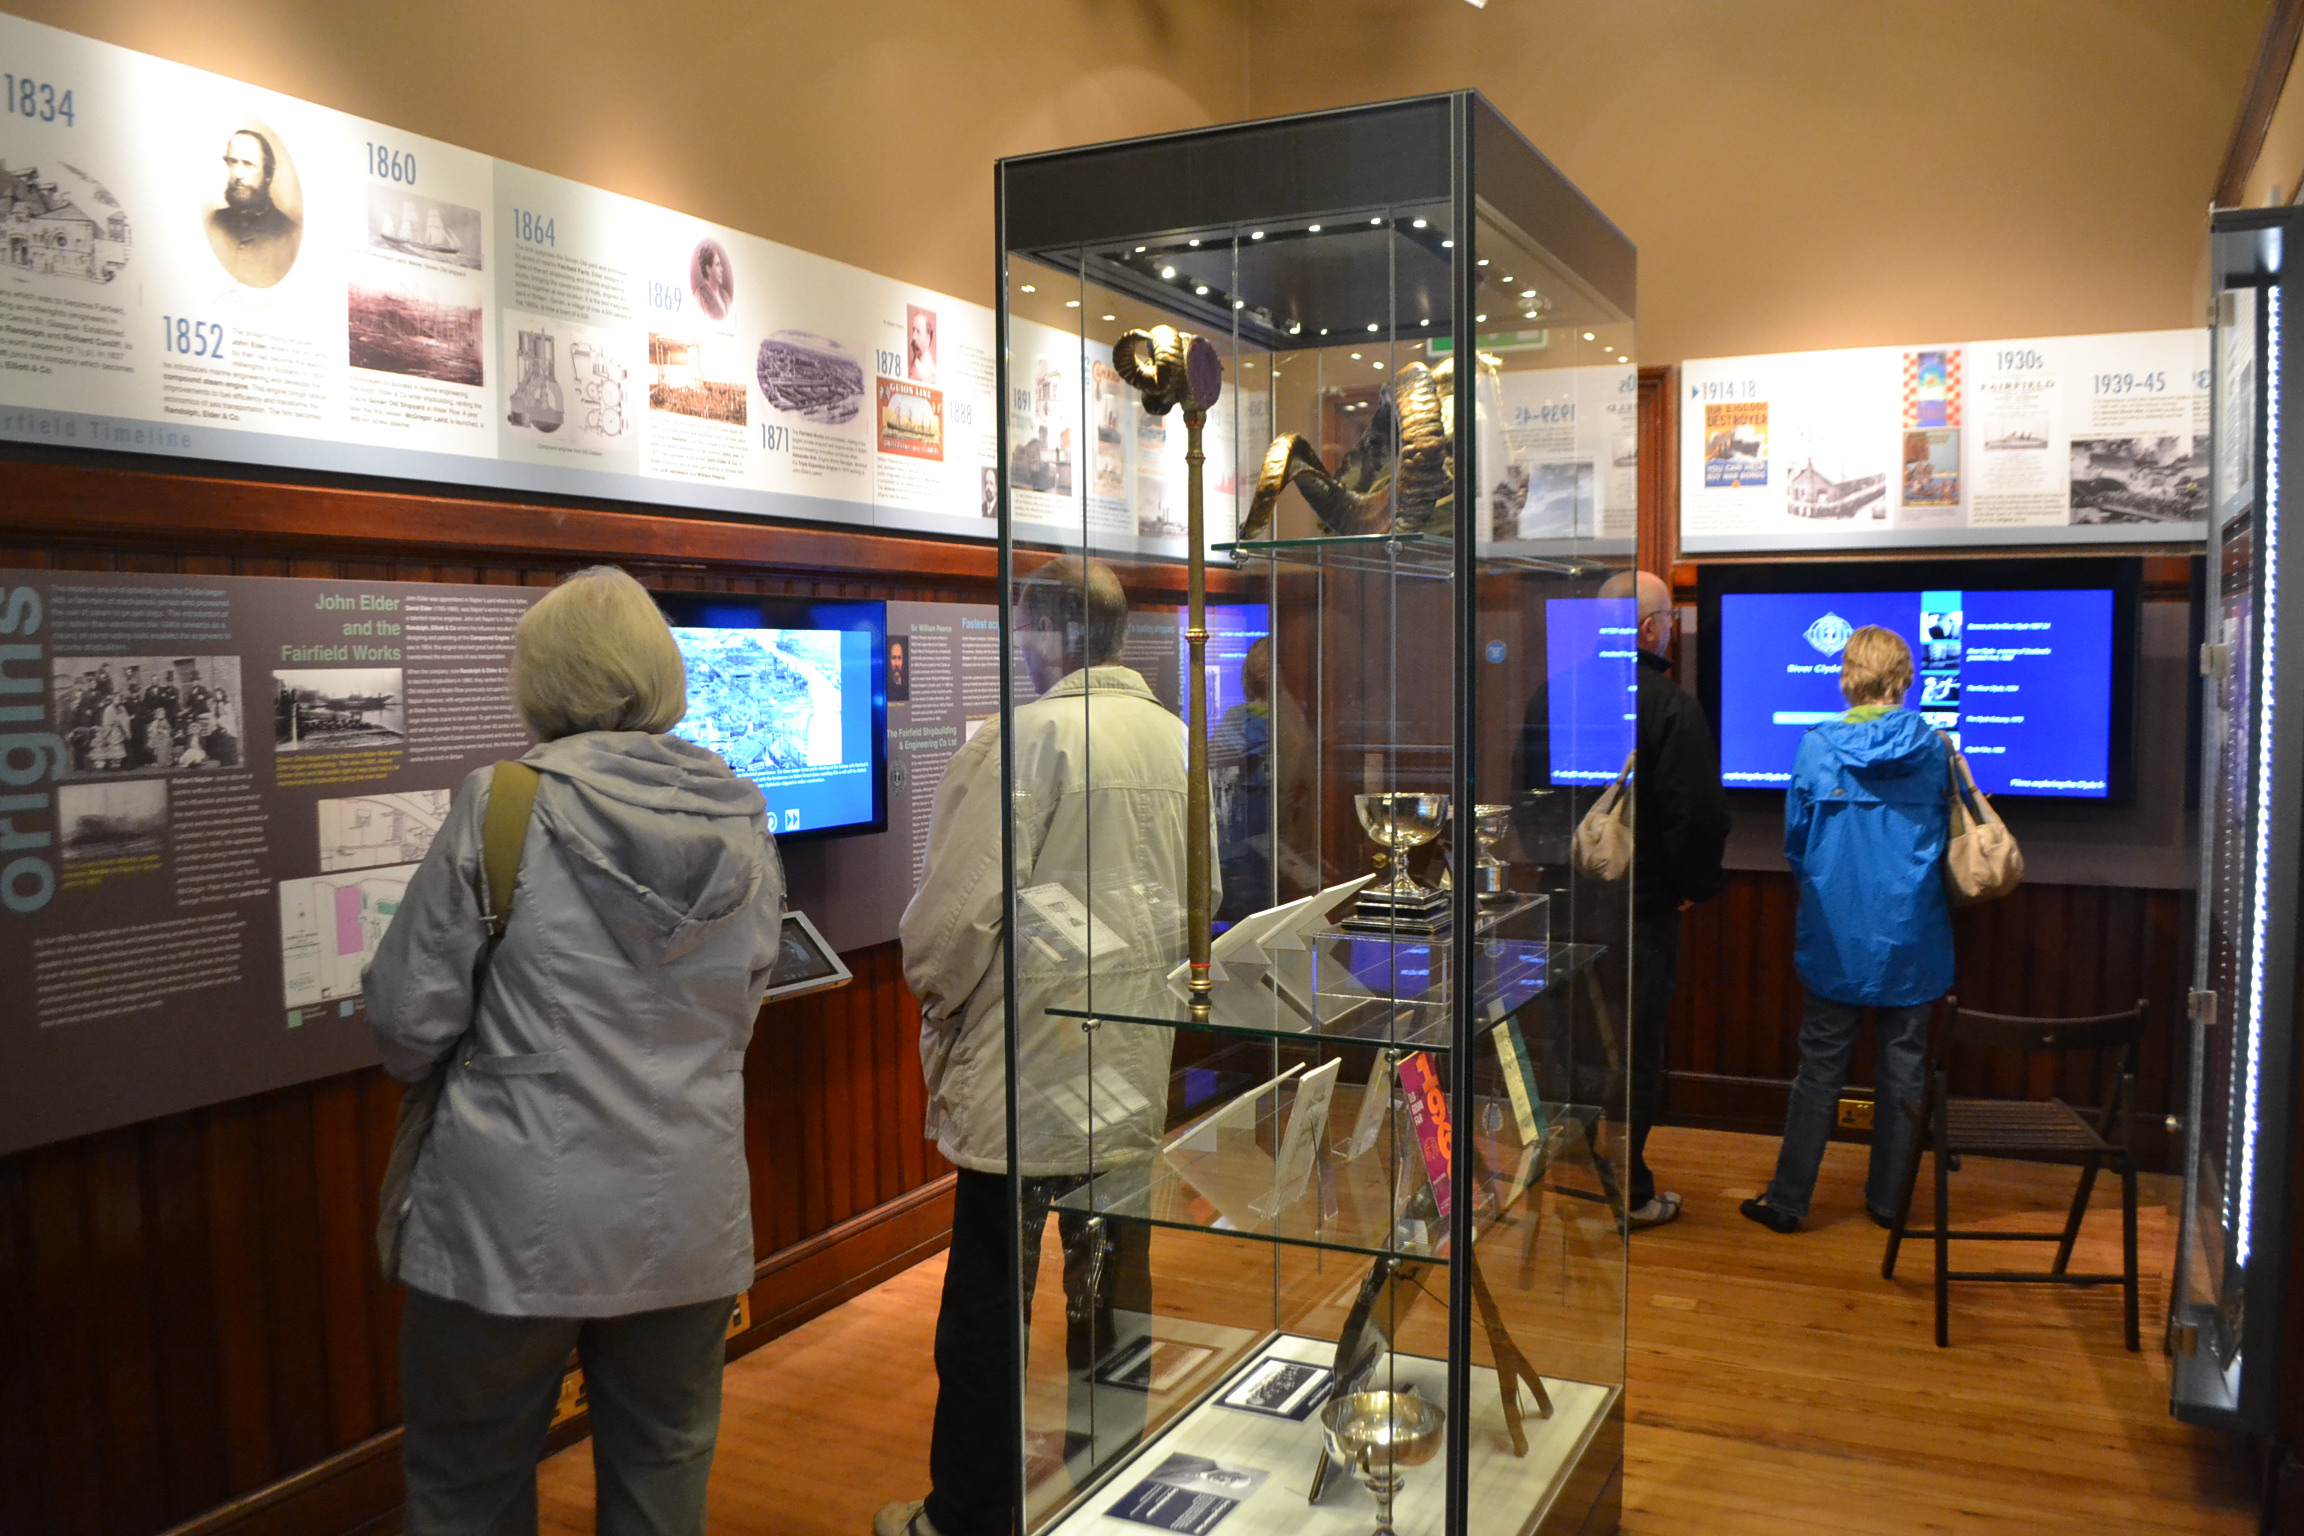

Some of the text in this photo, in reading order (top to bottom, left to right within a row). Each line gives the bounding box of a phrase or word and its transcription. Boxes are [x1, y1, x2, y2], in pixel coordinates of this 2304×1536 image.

[4, 73, 75, 127] 1834
[366, 141, 417, 185] 1860
[513, 207, 555, 247] 1864
[647, 280, 682, 312] 1869
[163, 315, 224, 359] 1852
[875, 348, 902, 377] 1878
[1996, 350, 2045, 371] 1930s
[915, 387, 932, 400] LINE
[1980, 379, 2056, 392] FAIRFIELD
[2093, 372, 2167, 395] 1939-45
[1012, 387, 1031, 413] 1891
[950, 401, 972, 425] 1888
[1706, 412, 1769, 428] DESTROYER
[89, 420, 193, 449] Timeline
[760, 423, 789, 453] 1871
[315, 593, 401, 611] John Elder
[343, 619, 401, 636] and the
[910, 623, 918, 633] Sir
[936, 624, 952, 634] Pearce
[961, 617, 987, 630] Fastest
[281, 644, 402, 662] Fairfield Works
[1786, 663, 1814, 674] River
[887, 725, 957, 739] The Fairfield Shipbuilding
[898, 736, 958, 752] & Engineering Co Ltd
[1415, 1051, 1452, 1181] 196
